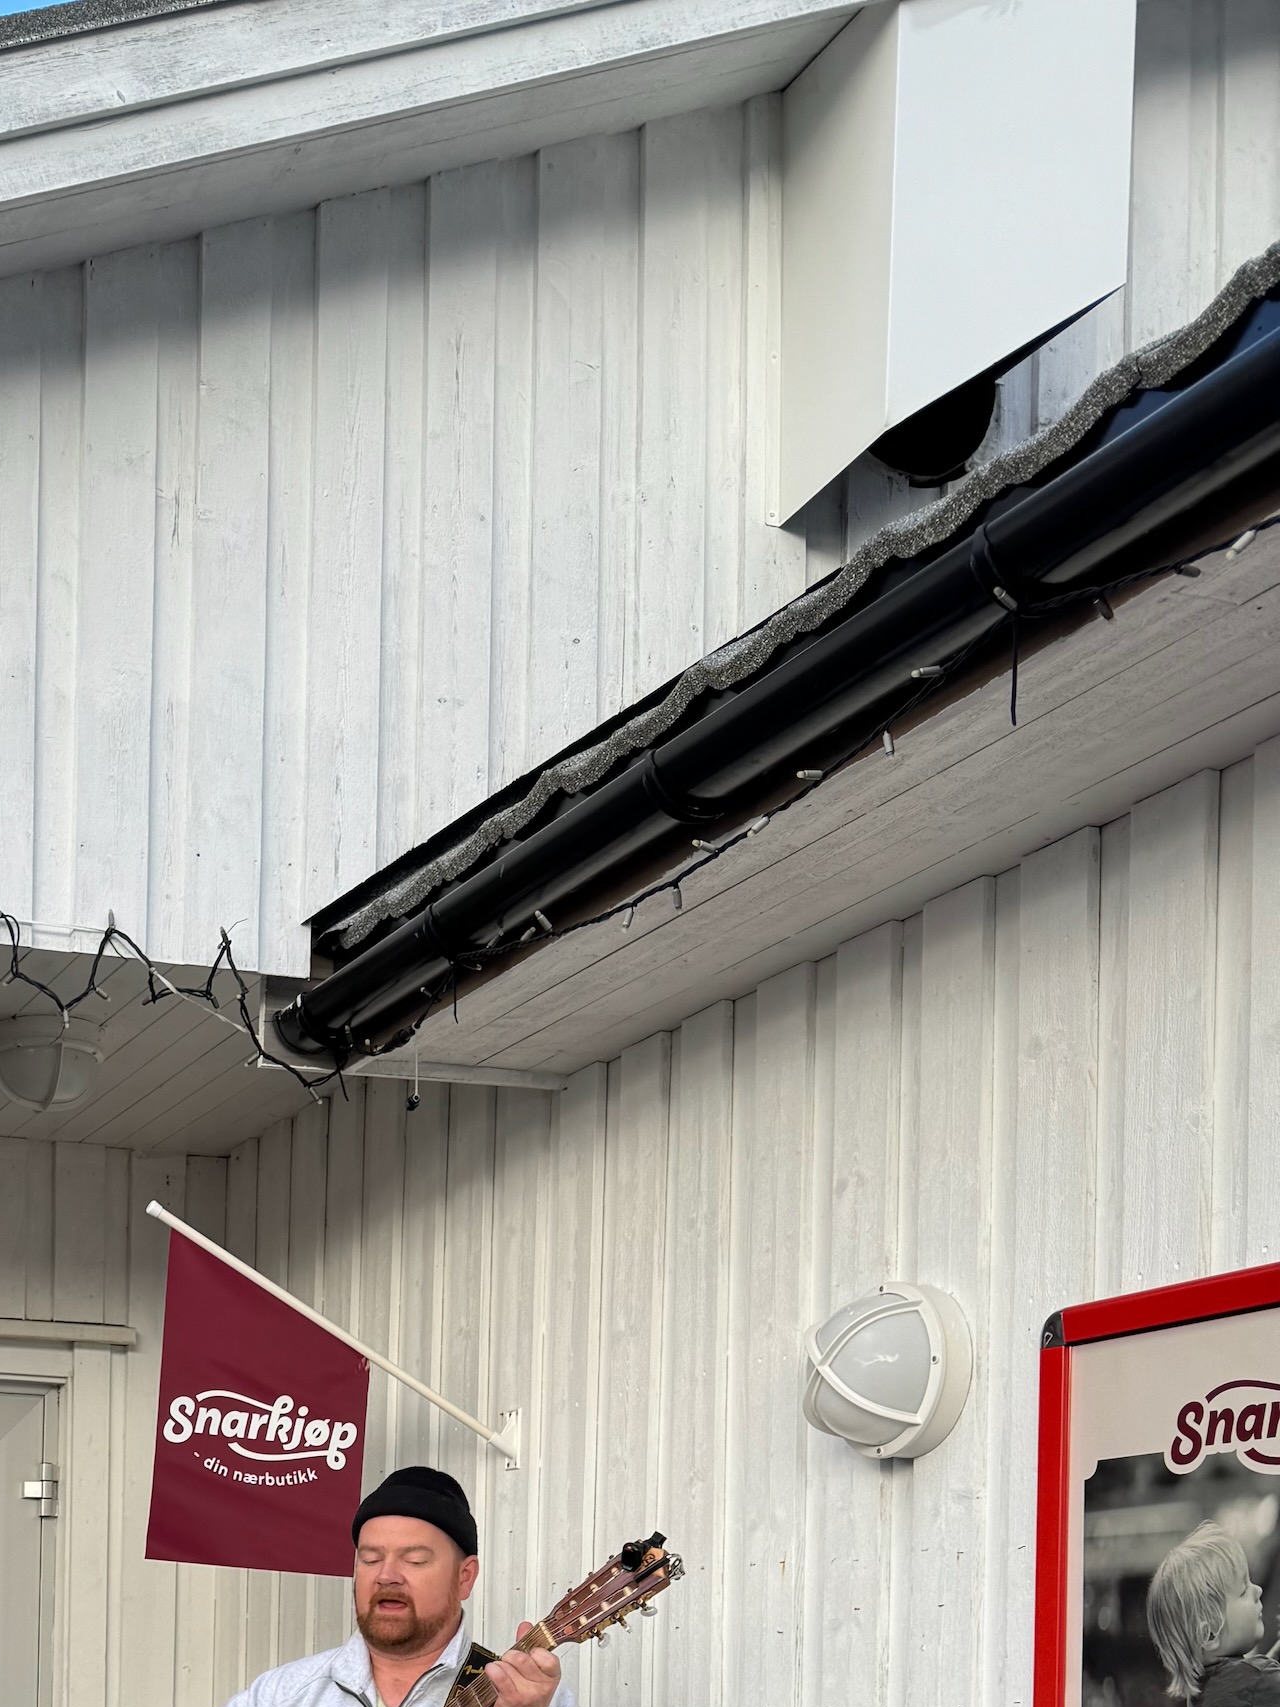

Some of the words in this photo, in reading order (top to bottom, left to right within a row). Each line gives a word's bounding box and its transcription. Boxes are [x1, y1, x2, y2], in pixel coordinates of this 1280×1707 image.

[162, 1389, 358, 1471] Snarkjøp
[203, 1456, 229, 1477] din
[232, 1467, 319, 1487] nærbutikk
